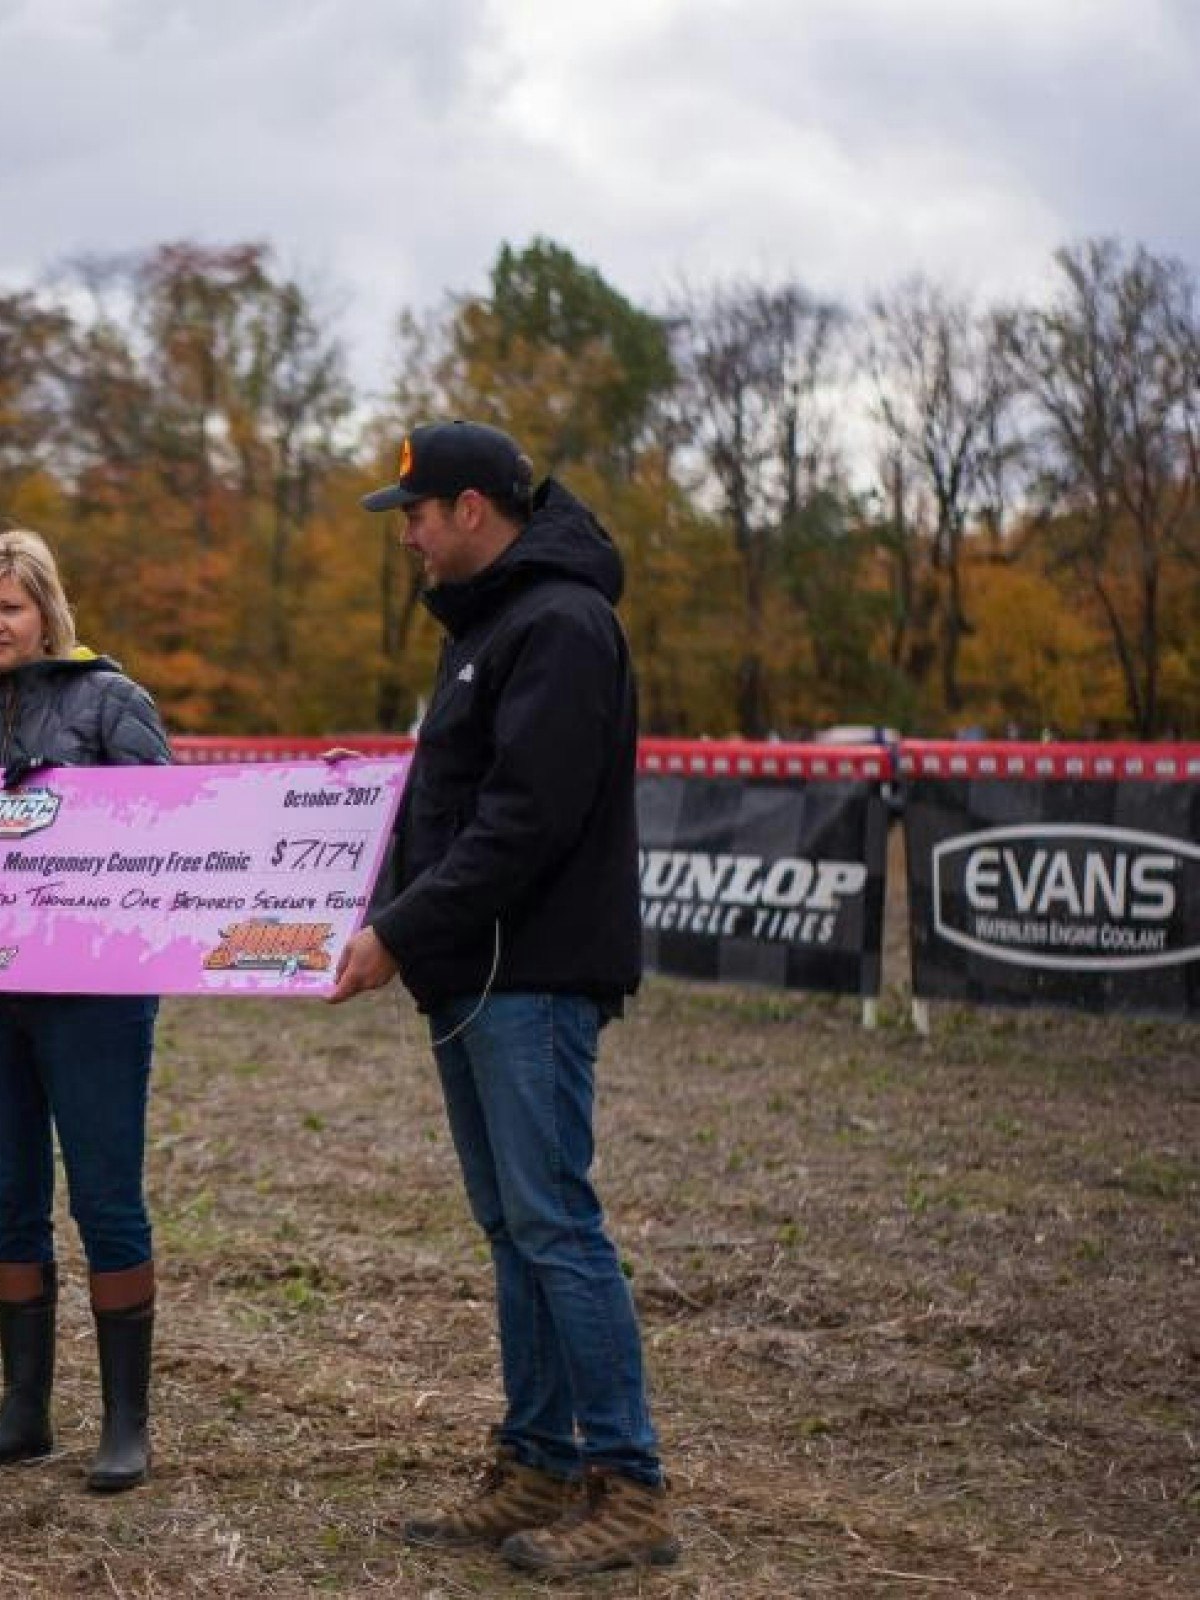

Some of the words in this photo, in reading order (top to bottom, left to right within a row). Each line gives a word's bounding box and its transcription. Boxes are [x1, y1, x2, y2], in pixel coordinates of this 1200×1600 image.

[283, 789, 342, 808] October
[343, 786, 381, 806] 2017
[3, 851, 105, 877] Montgomery
[106, 851, 164, 877] County
[166, 851, 202, 872] Free
[204, 851, 251, 872] Clinic
[271, 838, 365, 870] $7,174
[638, 850, 869, 910] UNLOP
[965, 847, 1177, 920] EVANS
[752, 907, 837, 945] TIRES
